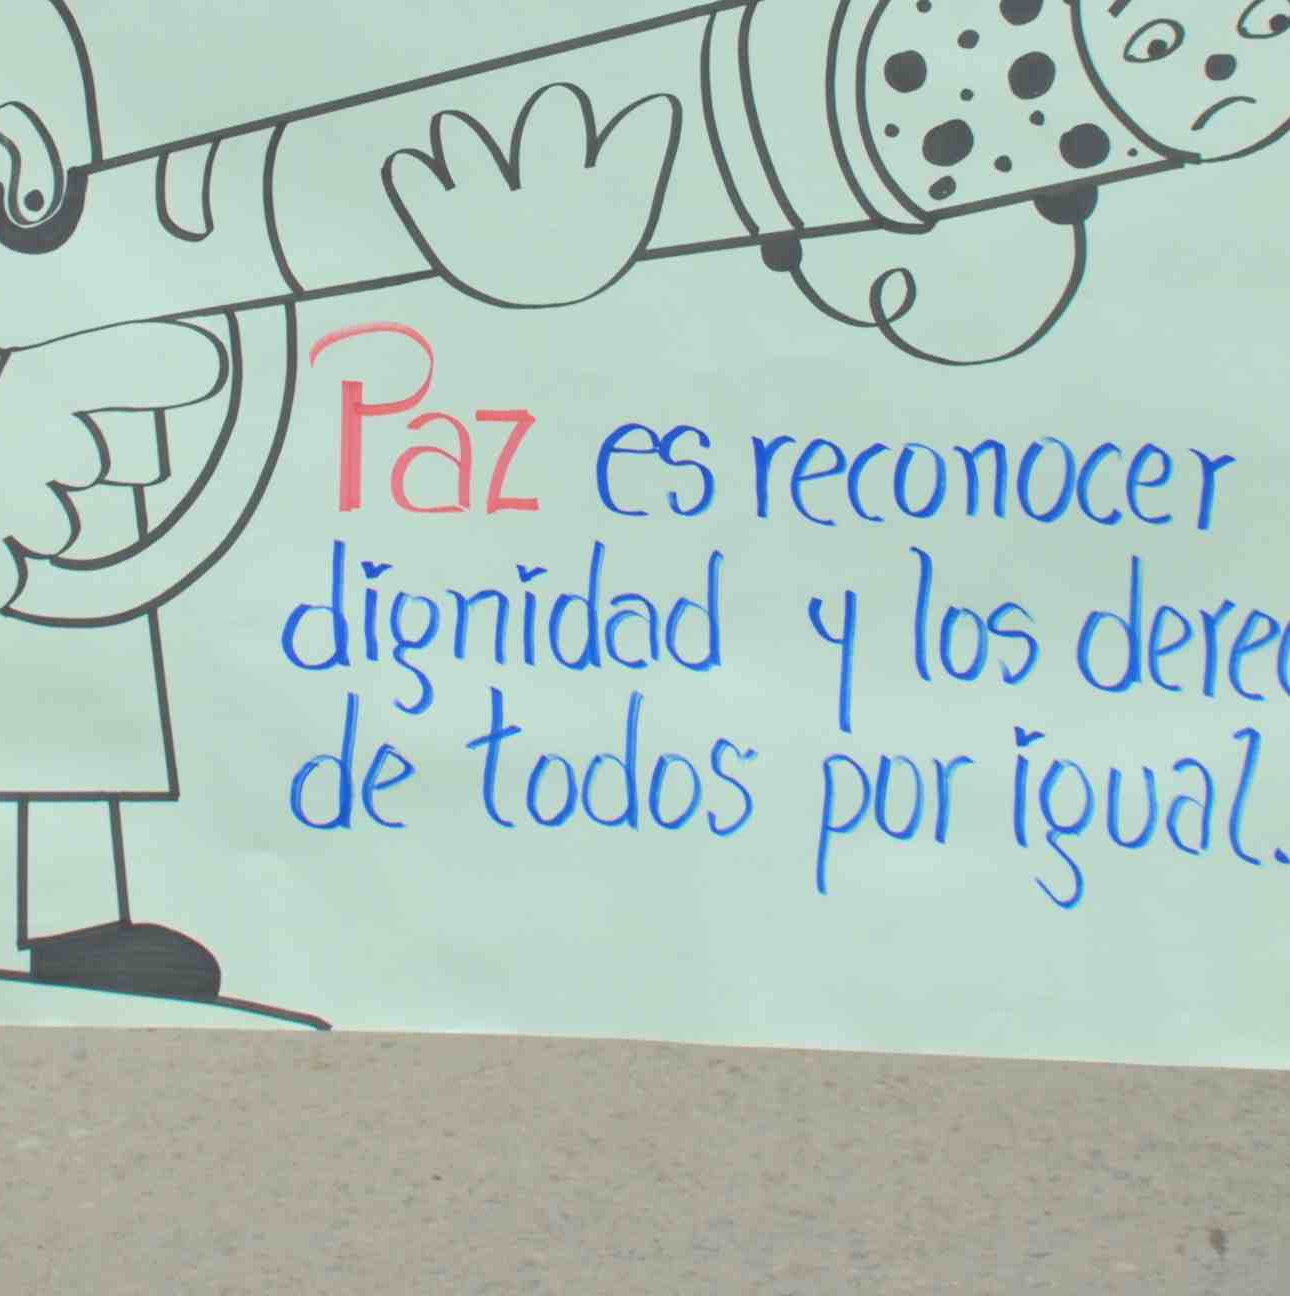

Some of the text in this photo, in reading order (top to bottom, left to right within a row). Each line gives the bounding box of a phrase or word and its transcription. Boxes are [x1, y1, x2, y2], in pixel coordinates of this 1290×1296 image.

[310, 321, 540, 513] Paz
[595, 421, 717, 519] es
[750, 433, 1239, 532] reconocer
[280, 540, 726, 717] dignidad
[807, 589, 858, 735] y
[909, 546, 1041, 686] los
[288, 692, 417, 833] de
[466, 686, 760, 840] todos
[816, 749, 977, 897] por
